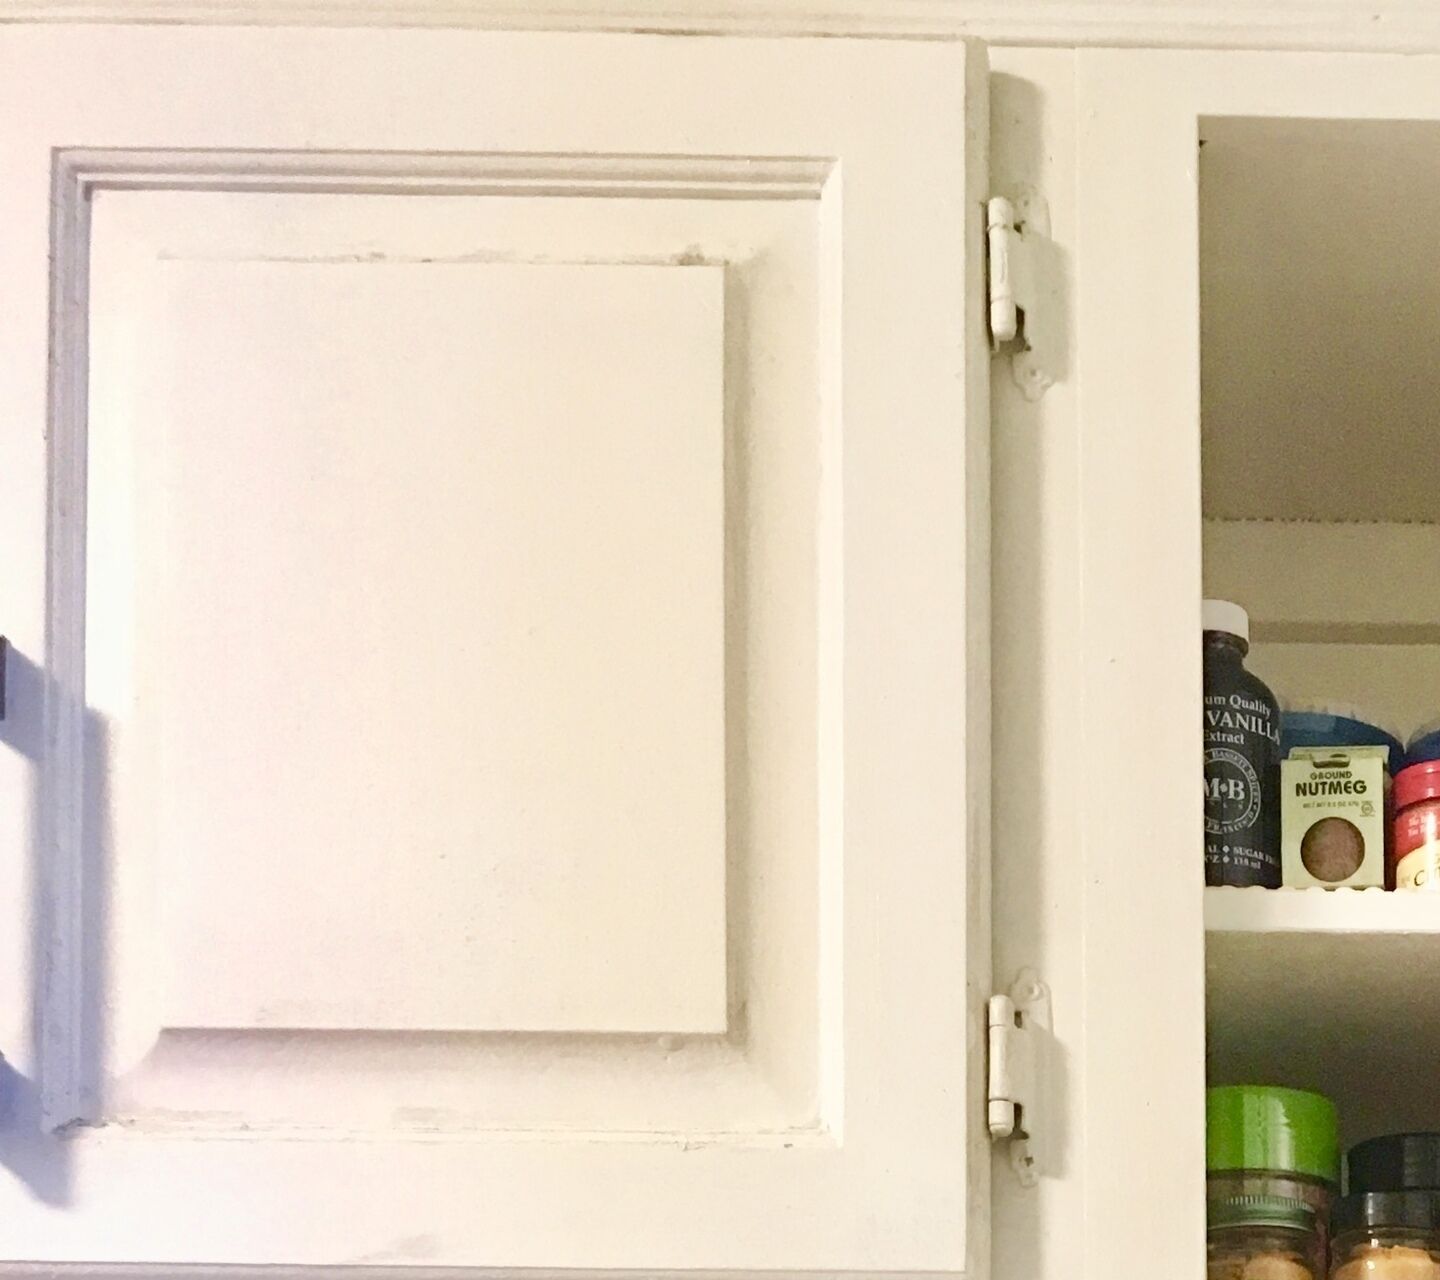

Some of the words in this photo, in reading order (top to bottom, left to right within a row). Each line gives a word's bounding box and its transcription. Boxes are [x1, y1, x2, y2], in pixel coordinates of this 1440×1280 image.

[1230, 694, 1272, 719] Quality
[1206, 710, 1280, 747] VANILLA
[1310, 770, 1353, 781] GROUND
[1295, 780, 1368, 797] NUTMEG
